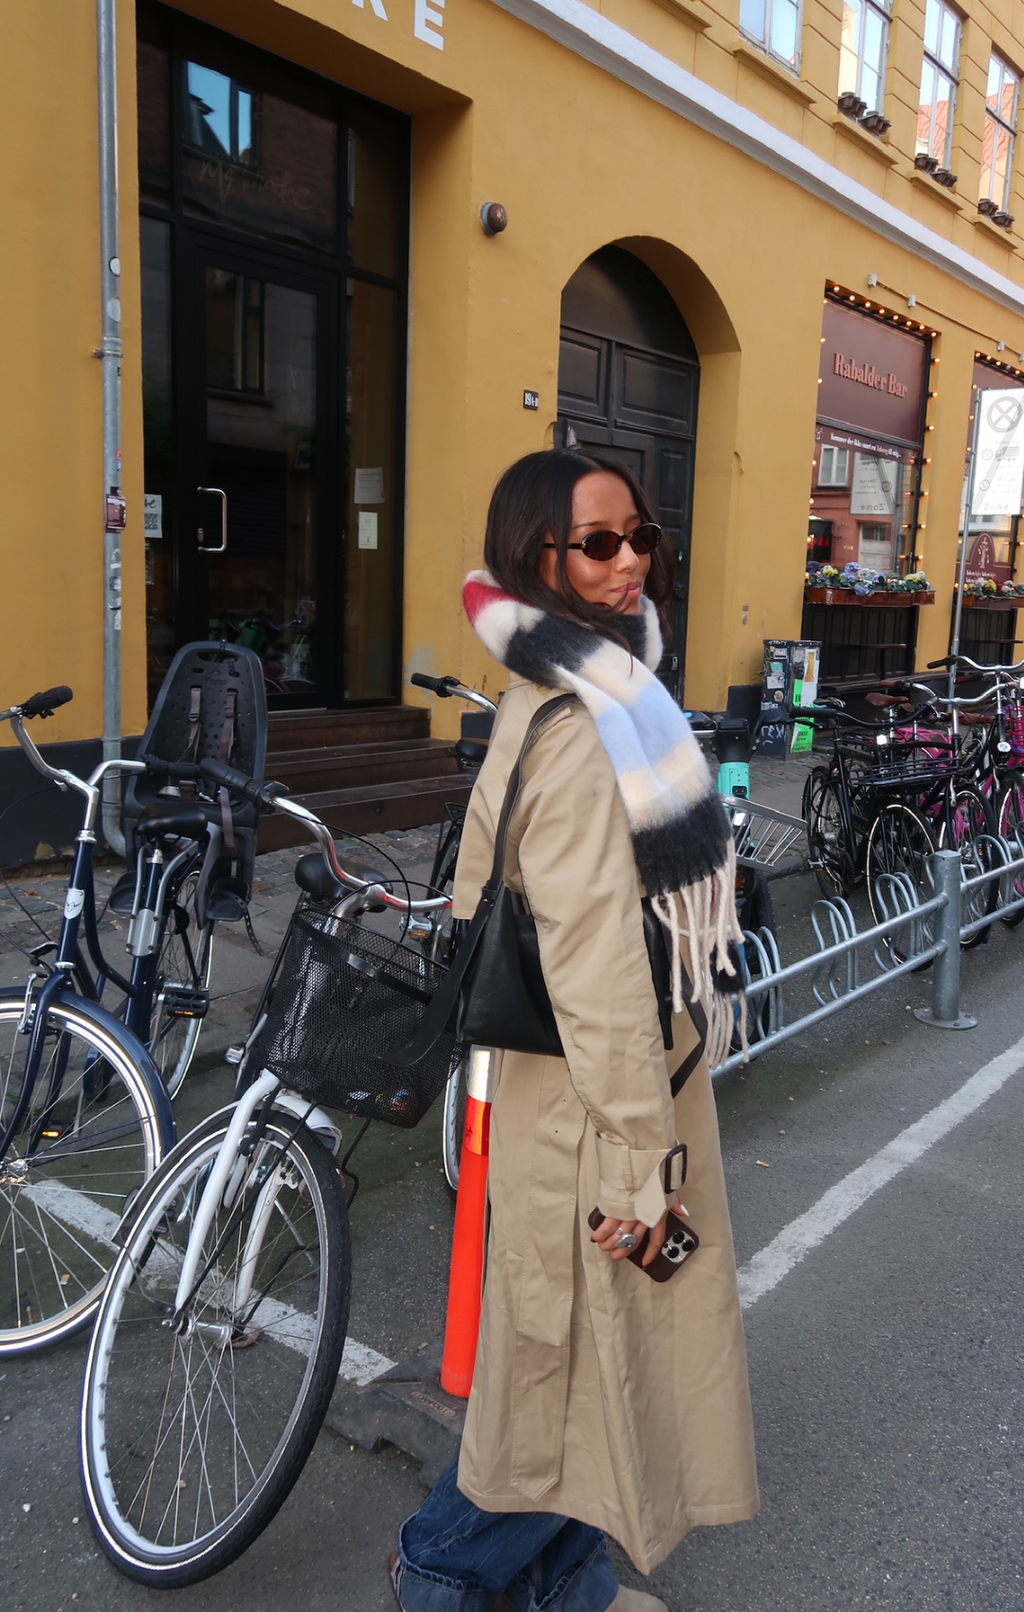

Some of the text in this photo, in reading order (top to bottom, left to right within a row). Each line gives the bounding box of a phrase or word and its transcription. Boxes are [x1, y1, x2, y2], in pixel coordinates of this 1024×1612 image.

[834, 353, 908, 398] Rabalder Bar
[983, 503, 1009, 511] Zone
[203, 676, 227, 687] Yepp
